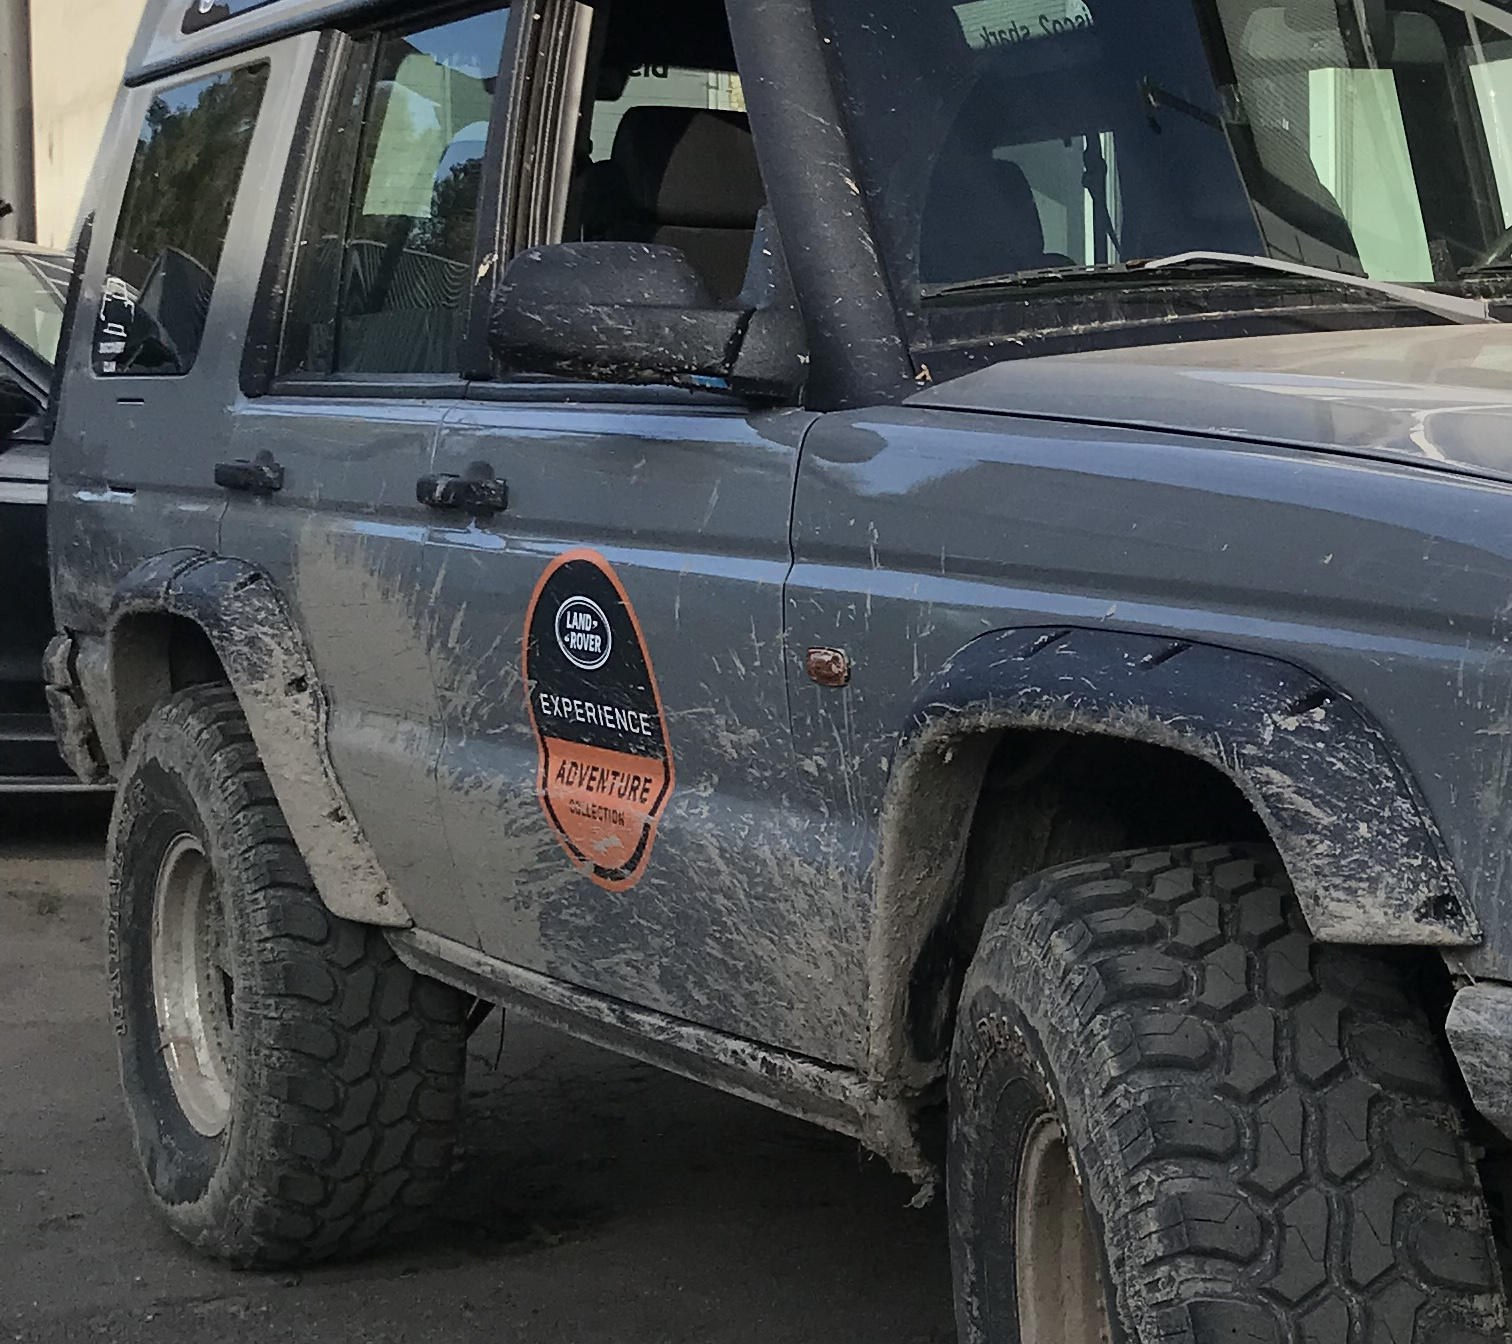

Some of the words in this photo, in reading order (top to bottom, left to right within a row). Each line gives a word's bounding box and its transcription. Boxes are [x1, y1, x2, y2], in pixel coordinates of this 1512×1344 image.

[565, 610, 592, 633] LAND
[569, 630, 602, 653] ROVER
[539, 693, 652, 736] EXPERIENCE
[555, 759, 653, 805] ADVENTURE
[569, 798, 625, 827] COLLECTION
